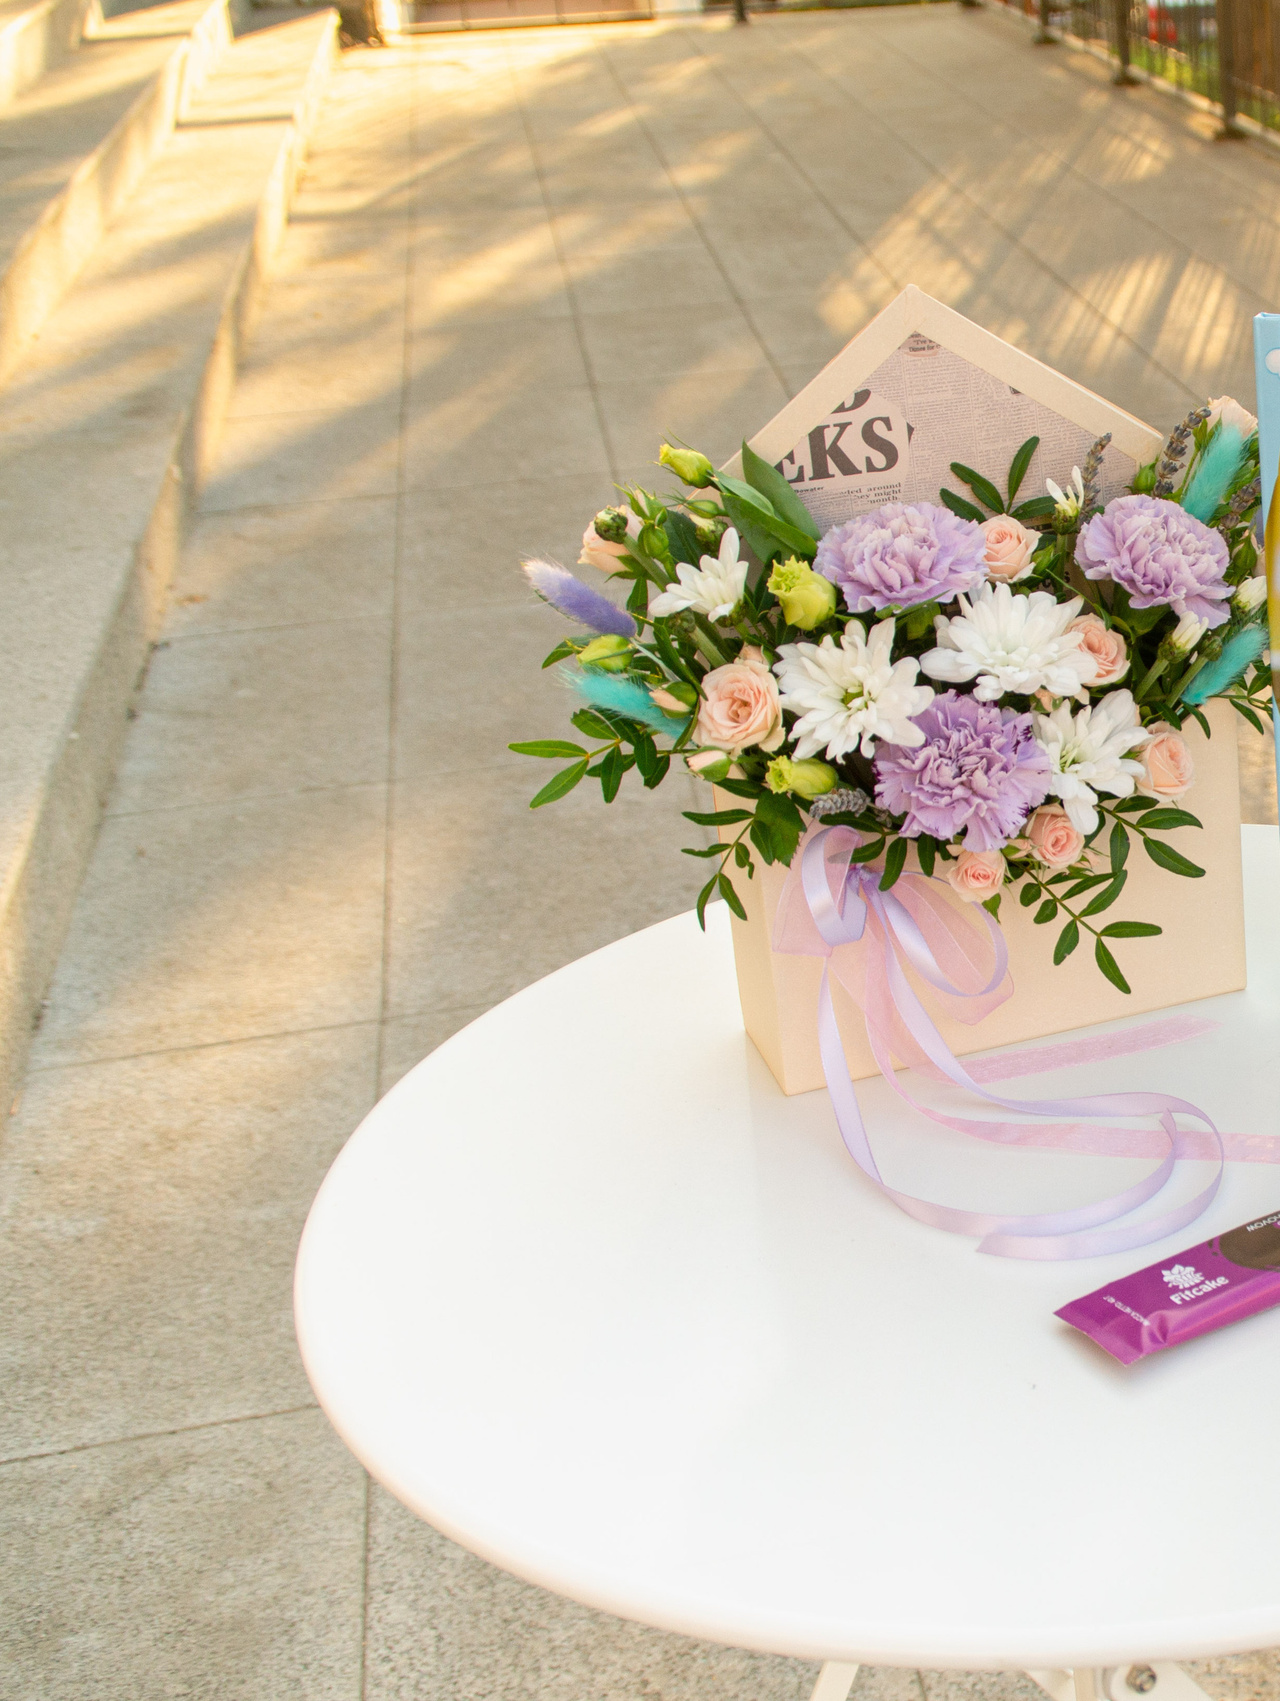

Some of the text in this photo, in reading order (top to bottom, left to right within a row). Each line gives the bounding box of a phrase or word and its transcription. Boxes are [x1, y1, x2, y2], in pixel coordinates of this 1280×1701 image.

[866, 482, 902, 493] around
[874, 488, 902, 498] might
[1169, 1276, 1229, 1305] Fitcake
